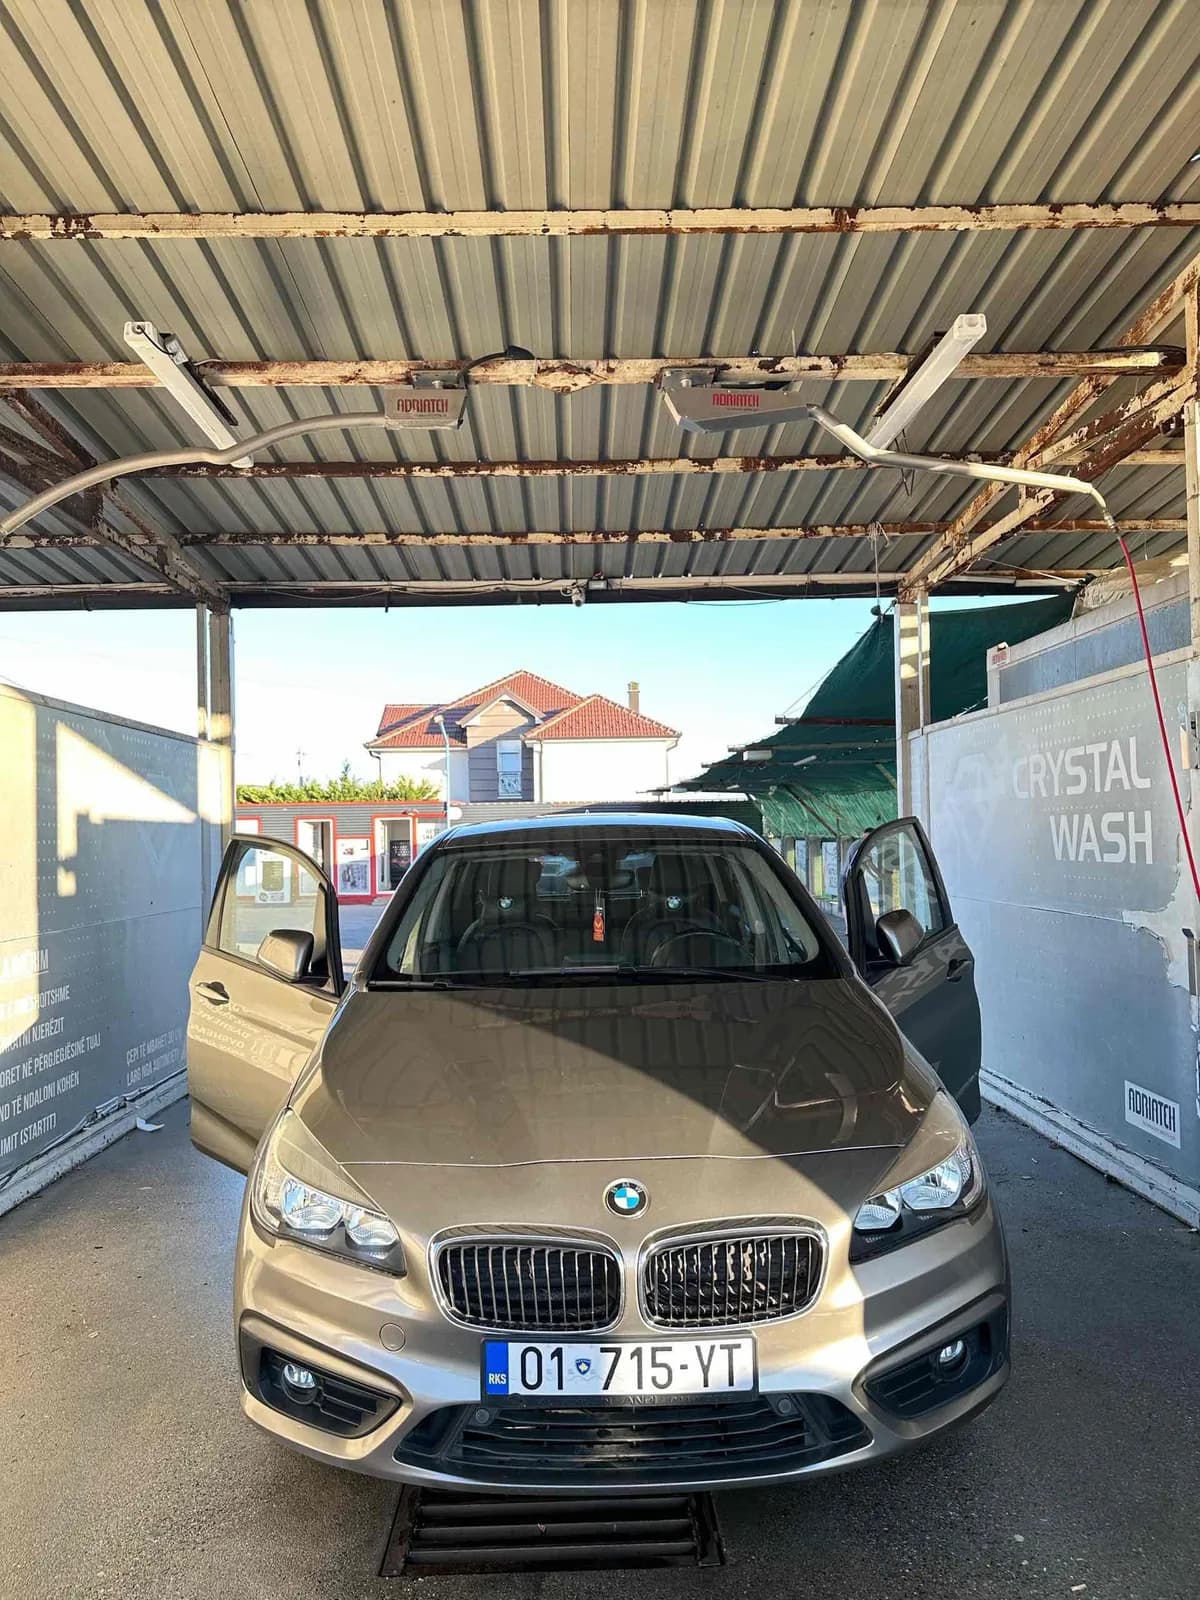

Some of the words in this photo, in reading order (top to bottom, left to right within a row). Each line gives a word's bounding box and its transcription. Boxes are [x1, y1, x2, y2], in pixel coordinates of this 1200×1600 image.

[1013, 736, 1151, 798] CRYSTAL
[1050, 810, 1153, 864] WASH
[488, 1373, 507, 1385] RKS
[520, 1346, 564, 1390] 01
[601, 1343, 742, 1390] 715-YT
